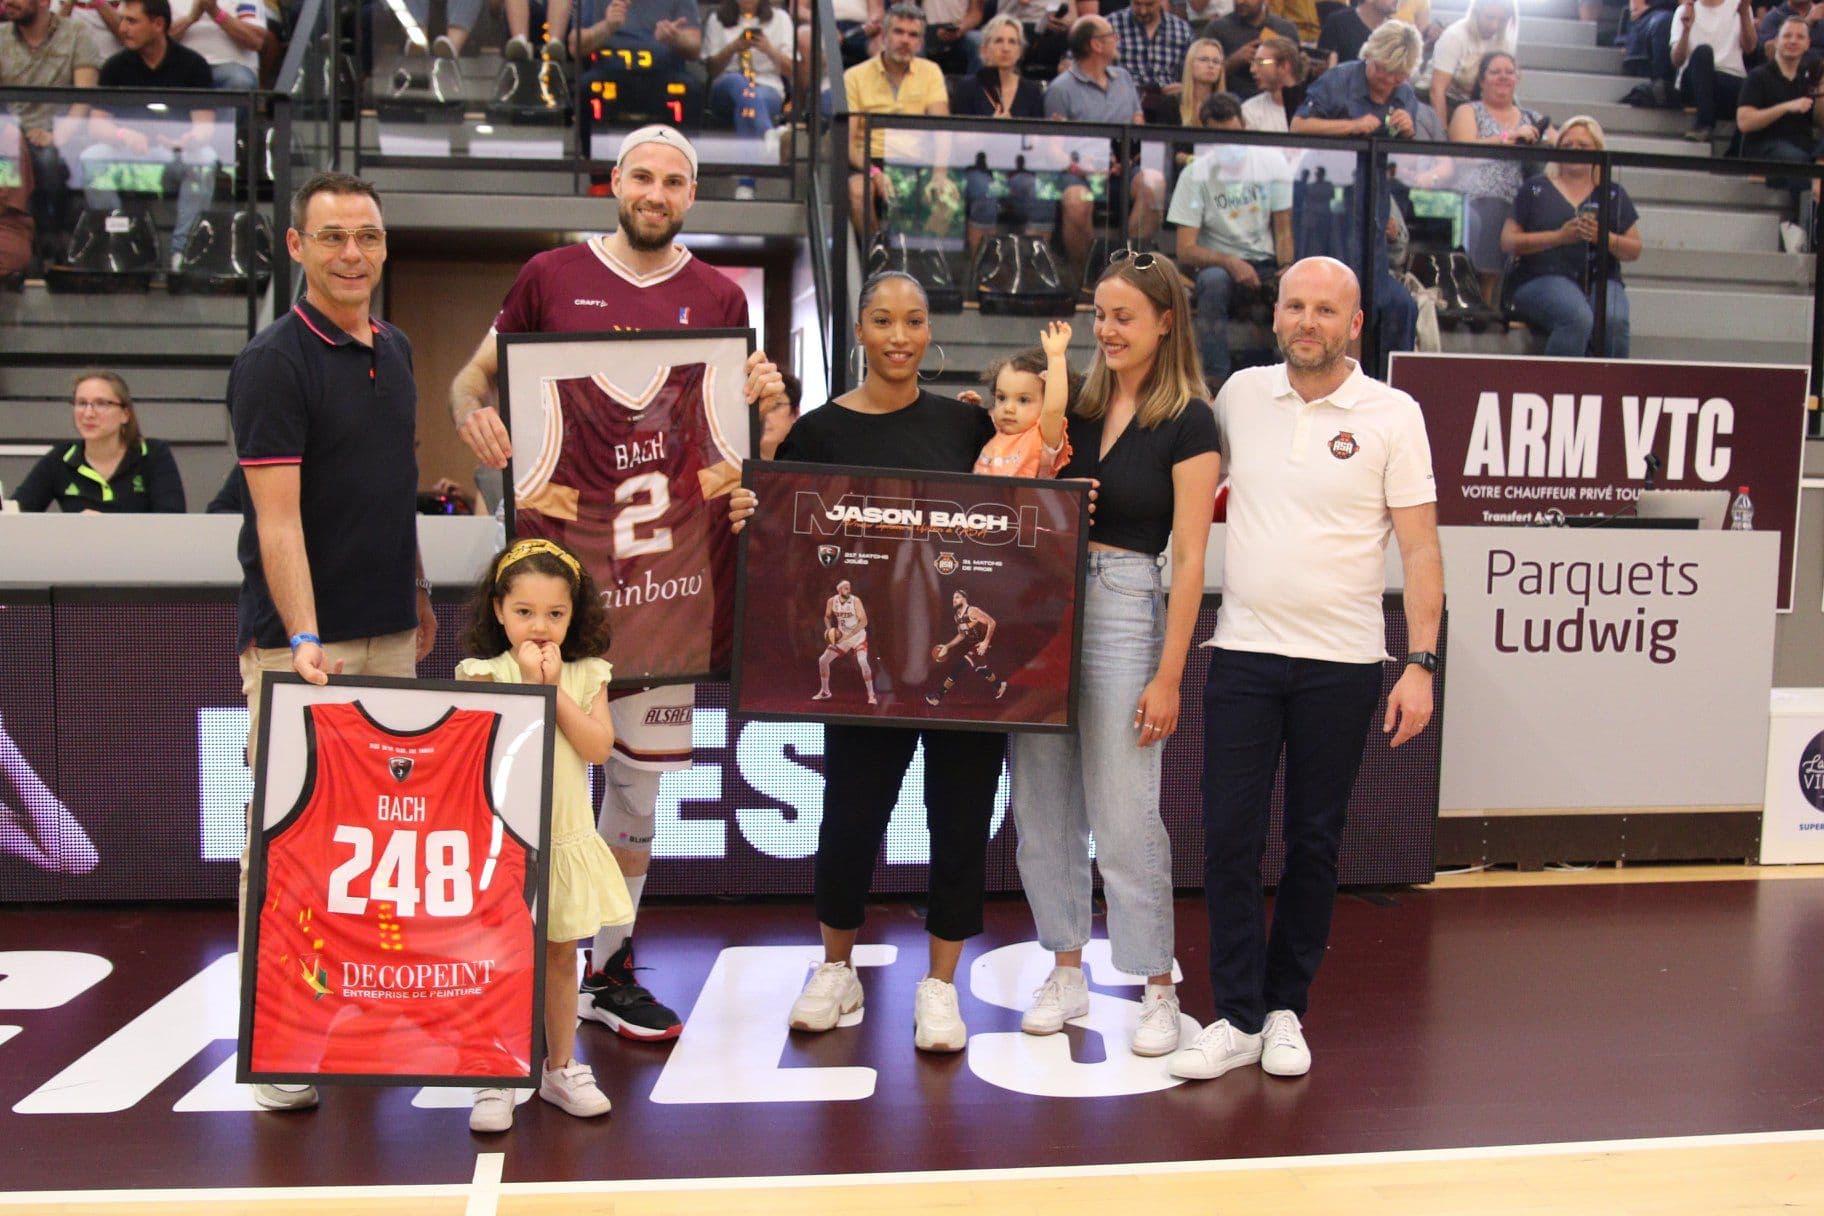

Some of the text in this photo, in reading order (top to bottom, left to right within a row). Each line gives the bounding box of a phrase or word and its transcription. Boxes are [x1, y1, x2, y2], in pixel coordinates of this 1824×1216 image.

[615, 431, 664, 470] BACH
[1462, 391, 1734, 483] ARM VTC
[1461, 486, 1501, 498] VOTRE
[1504, 485, 1577, 500] CHAUFFEUR
[1580, 485, 1612, 501] PRIVÉ
[613, 470, 673, 560] 2
[825, 505, 923, 526] JASON
[930, 511, 1008, 532] BACH
[1482, 510, 1532, 522] Transfert
[601, 570, 702, 610] ainbow
[1486, 549, 1699, 606] Parquets
[1494, 607, 1679, 664] Ludwig
[378, 795, 426, 822] BACH
[327, 825, 474, 917] 248
[342, 960, 495, 989] DECOPEINT
[343, 988, 409, 999] ENTREPRISE
[430, 987, 482, 998] PEINTURE
